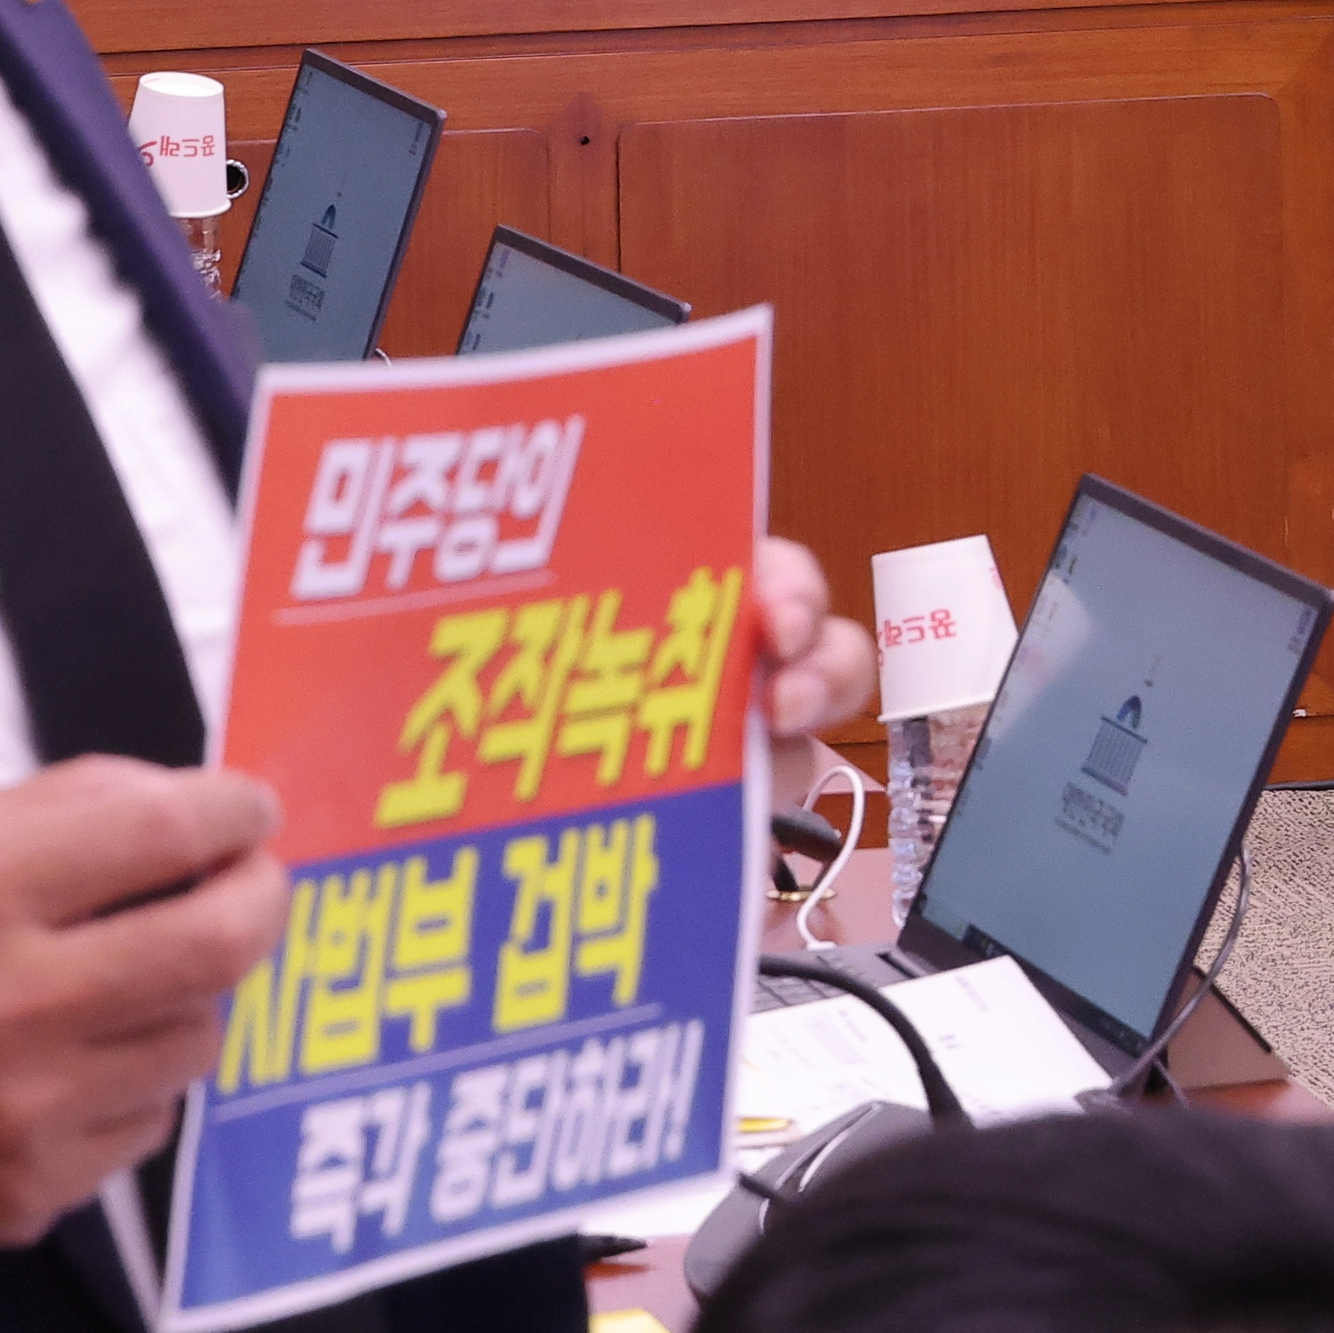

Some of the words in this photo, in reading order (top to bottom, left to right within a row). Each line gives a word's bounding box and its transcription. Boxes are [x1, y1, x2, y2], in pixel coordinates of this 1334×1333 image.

[288, 412, 588, 600] 민주당의
[217, 845, 480, 1096] 사법부
[491, 812, 660, 1034] 겁박
[288, 1080, 434, 1256] 즉각
